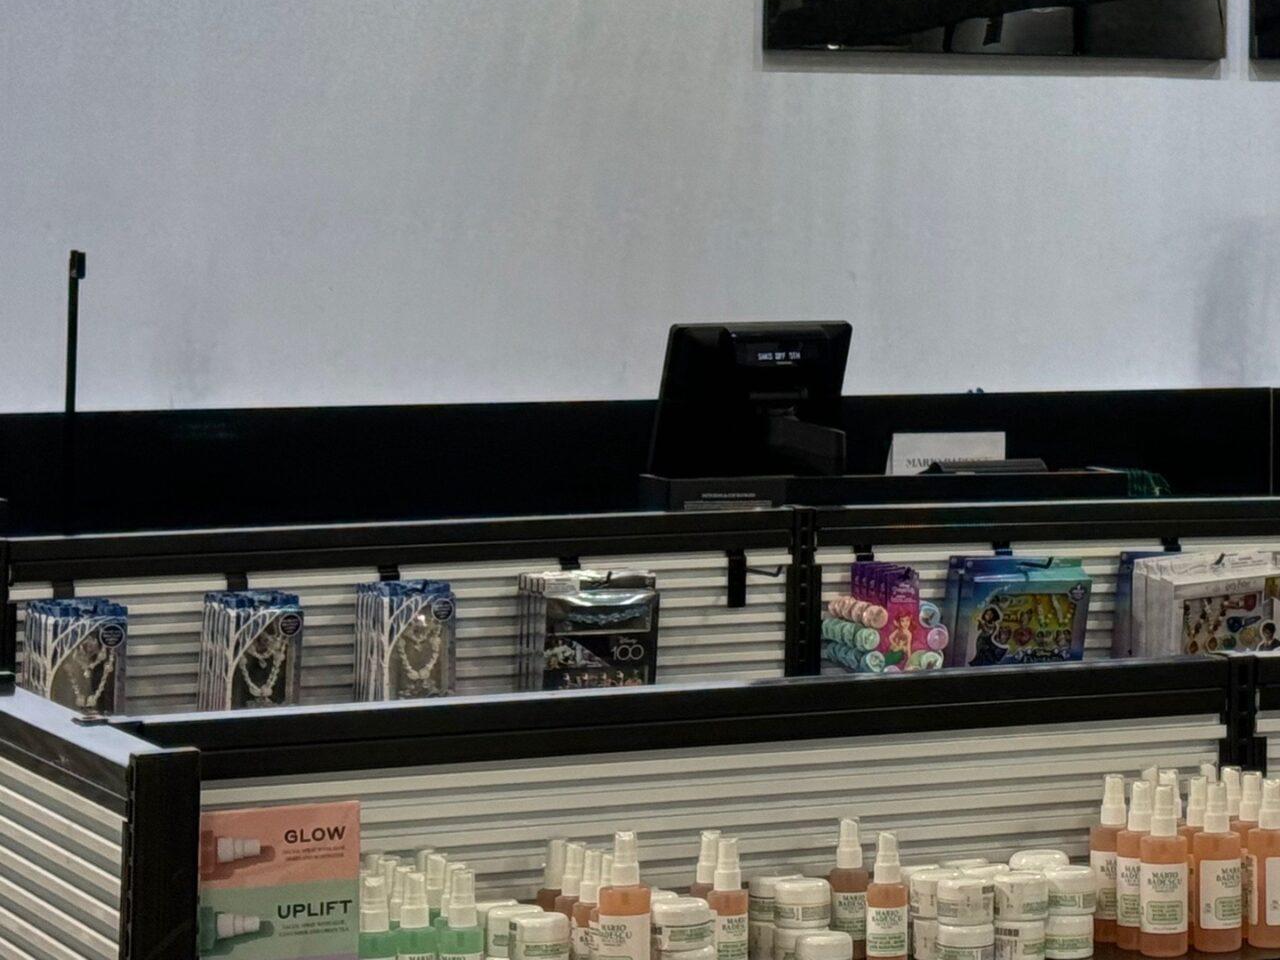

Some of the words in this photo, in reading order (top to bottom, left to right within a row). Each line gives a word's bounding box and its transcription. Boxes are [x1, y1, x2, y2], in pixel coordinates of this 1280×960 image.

[611, 643, 645, 661] 100
[284, 825, 346, 844] GLOW
[277, 899, 353, 919] UPLIFT
